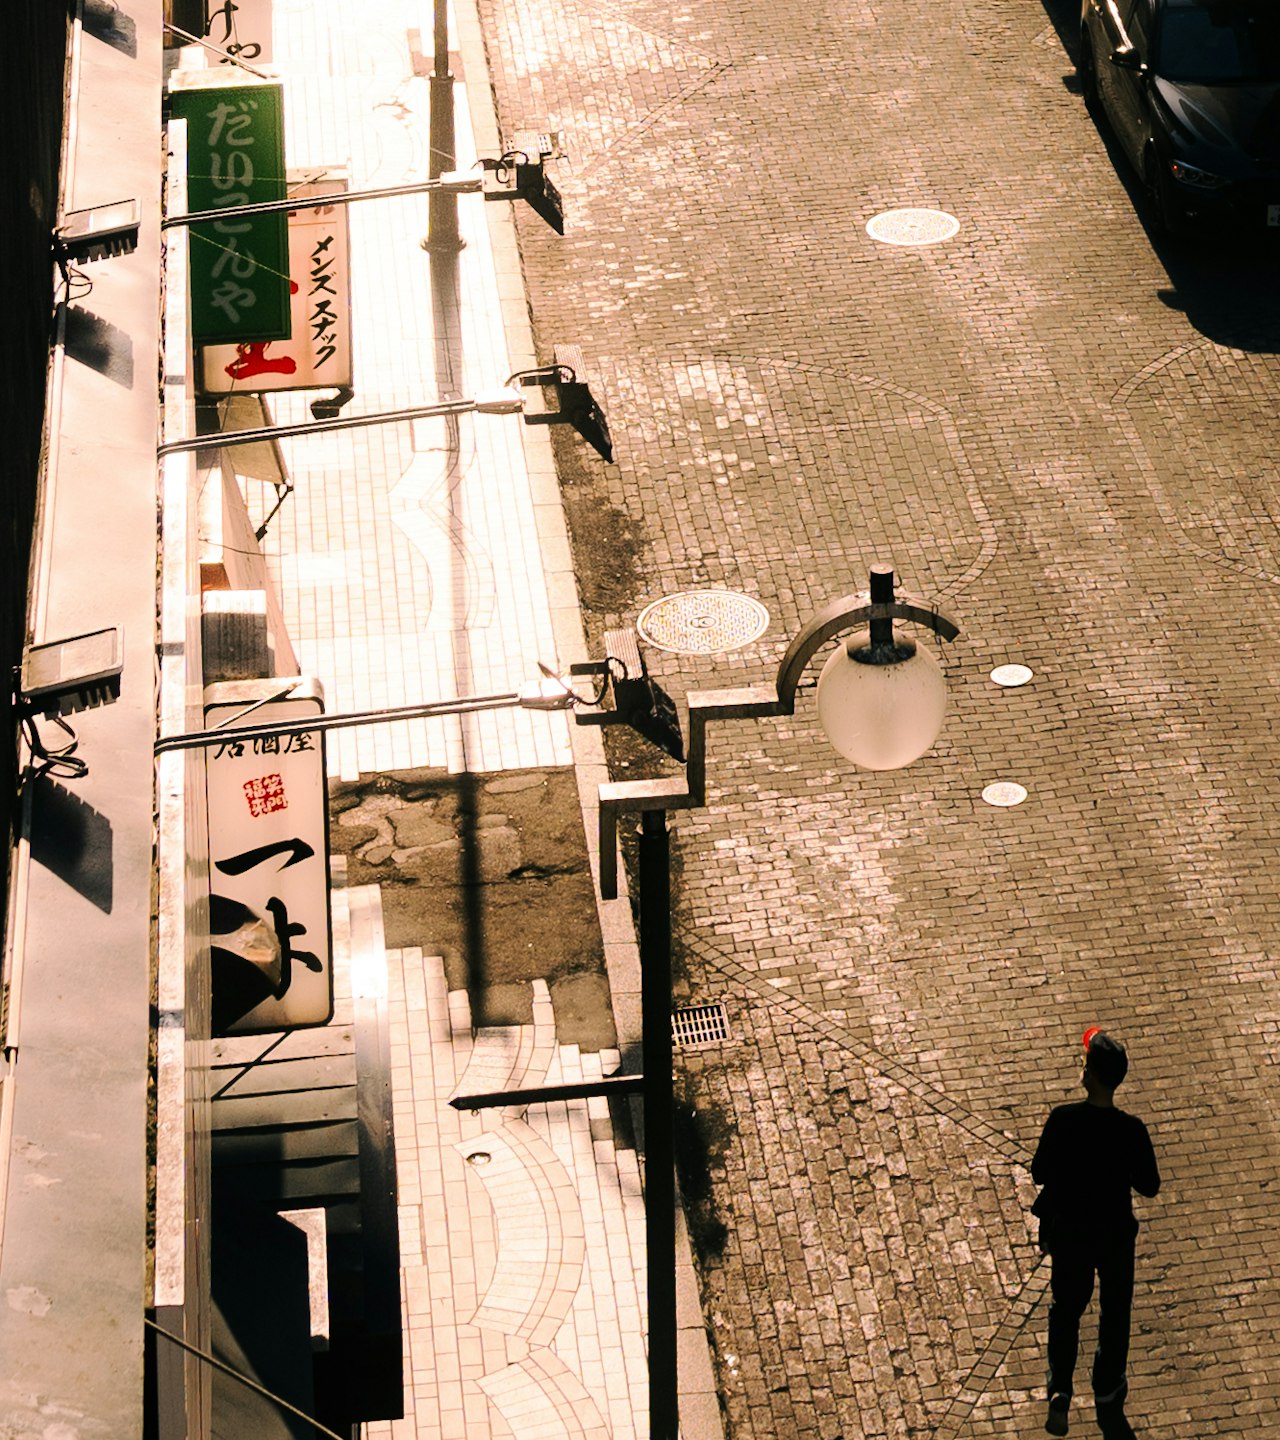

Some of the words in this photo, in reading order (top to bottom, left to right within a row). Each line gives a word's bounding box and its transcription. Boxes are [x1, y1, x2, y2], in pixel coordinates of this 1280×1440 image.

[206, 100, 258, 324] だいこんや
[308, 235, 337, 298] メンズ
[308, 299, 339, 370] スナック
